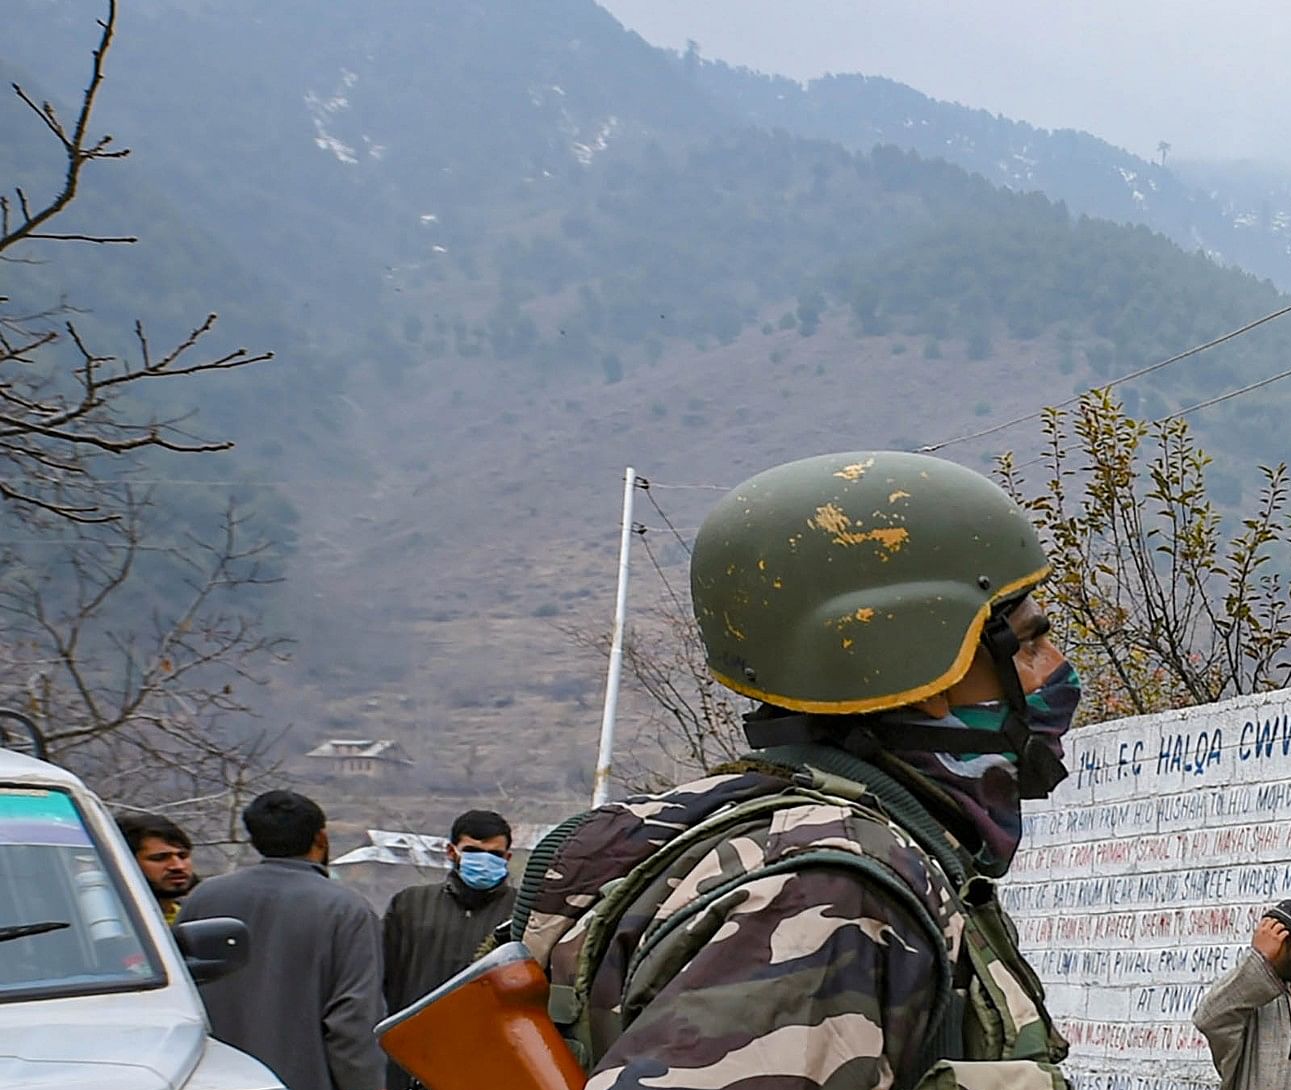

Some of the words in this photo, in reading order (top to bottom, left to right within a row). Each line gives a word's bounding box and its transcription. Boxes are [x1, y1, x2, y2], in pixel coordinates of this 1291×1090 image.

[1157, 728, 1222, 776] HALQA
[1100, 805, 1130, 828] FROM
[1137, 988, 1155, 1012] AT
